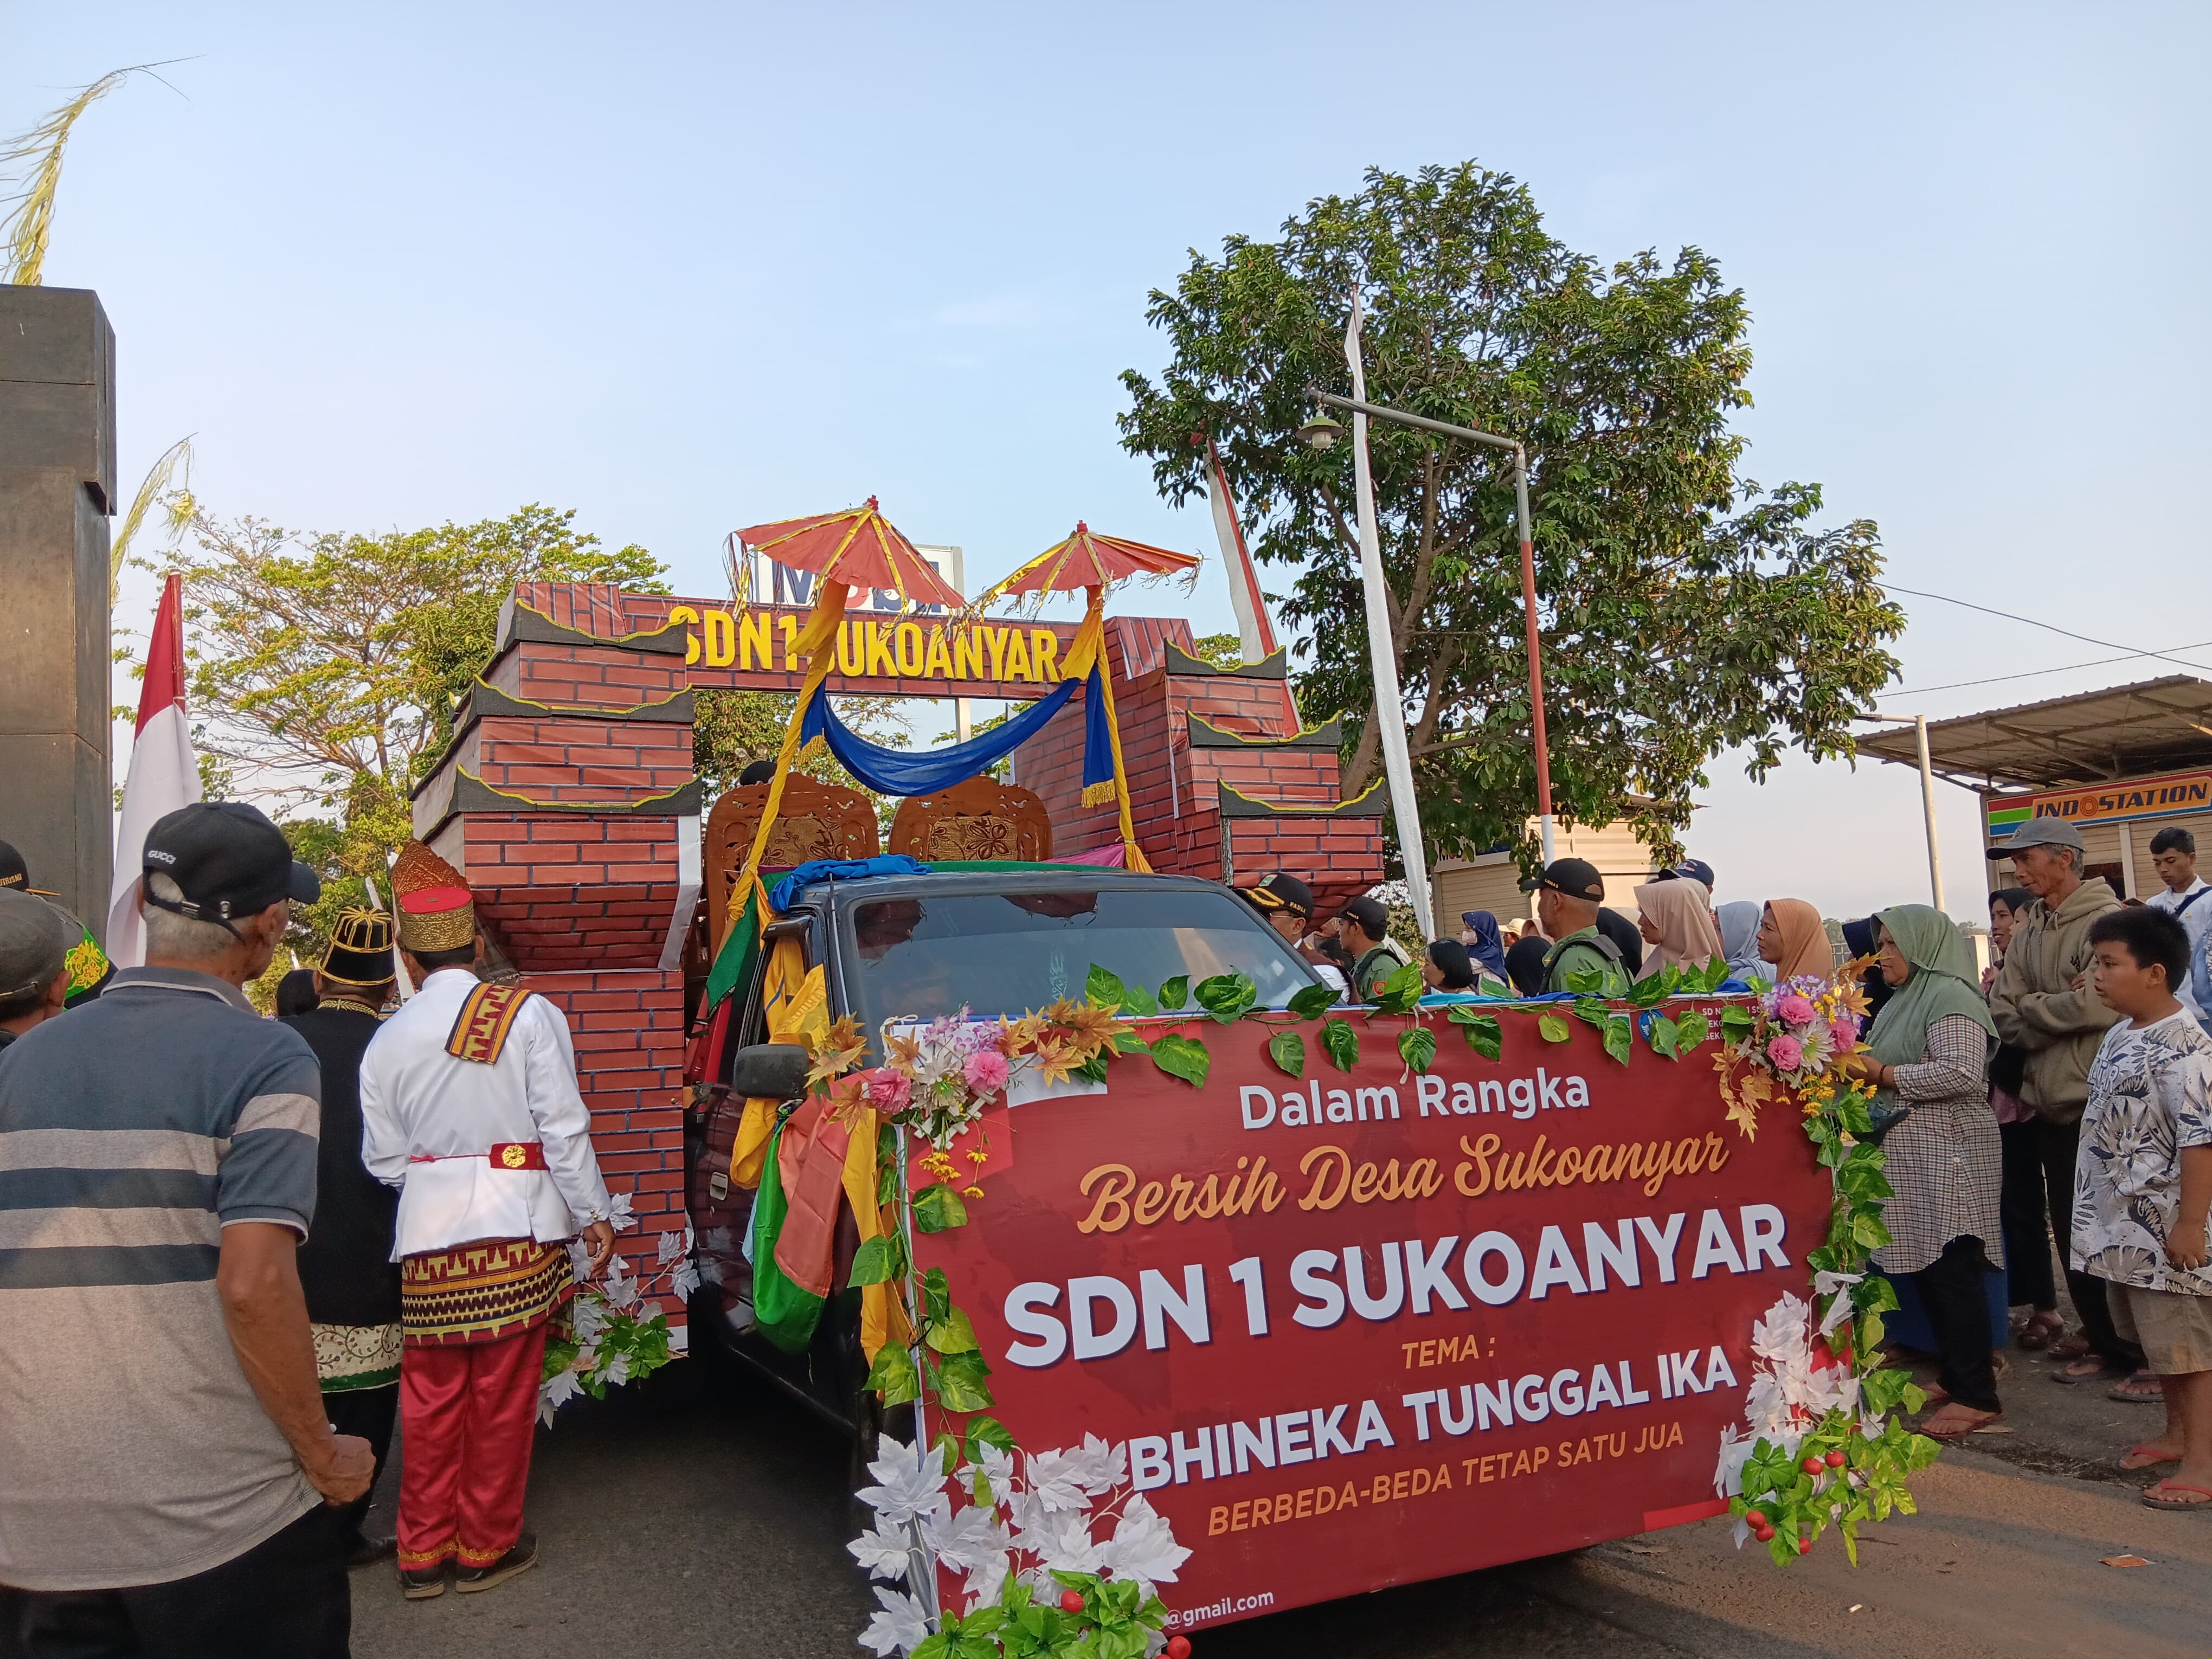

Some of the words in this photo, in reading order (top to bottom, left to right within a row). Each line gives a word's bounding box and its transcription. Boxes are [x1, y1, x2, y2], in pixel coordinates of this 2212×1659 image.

[669, 606, 773, 671] SDN
[777, 615, 798, 672] 1
[806, 618, 1060, 682] UKOANYAR
[148, 850, 177, 864] GUCCI
[1239, 1079, 1400, 1129] Dalam
[1416, 1067, 1589, 1119] Rangka
[1077, 1155, 1287, 1233] Bersih
[1298, 1145, 1444, 1211] Desa
[1454, 1133, 1729, 1197] Sukoanyar
[1004, 1264, 1210, 1367] SDN
[1229, 1256, 1268, 1335] 1
[1290, 1204, 1791, 1327] SUKOANYAR
[1401, 1334, 1480, 1369] TEMA
[1129, 1399, 1394, 1491] BHINEKA
[1402, 1360, 1649, 1441] TUNGGAL
[1657, 1346, 1738, 1399] IKA
[1208, 1468, 1452, 1536] BERBEDA-BEDA
[1462, 1446, 1549, 1486] TETAP
[1558, 1431, 1626, 1467] SATU
[1634, 1422, 1683, 1452] JUA
